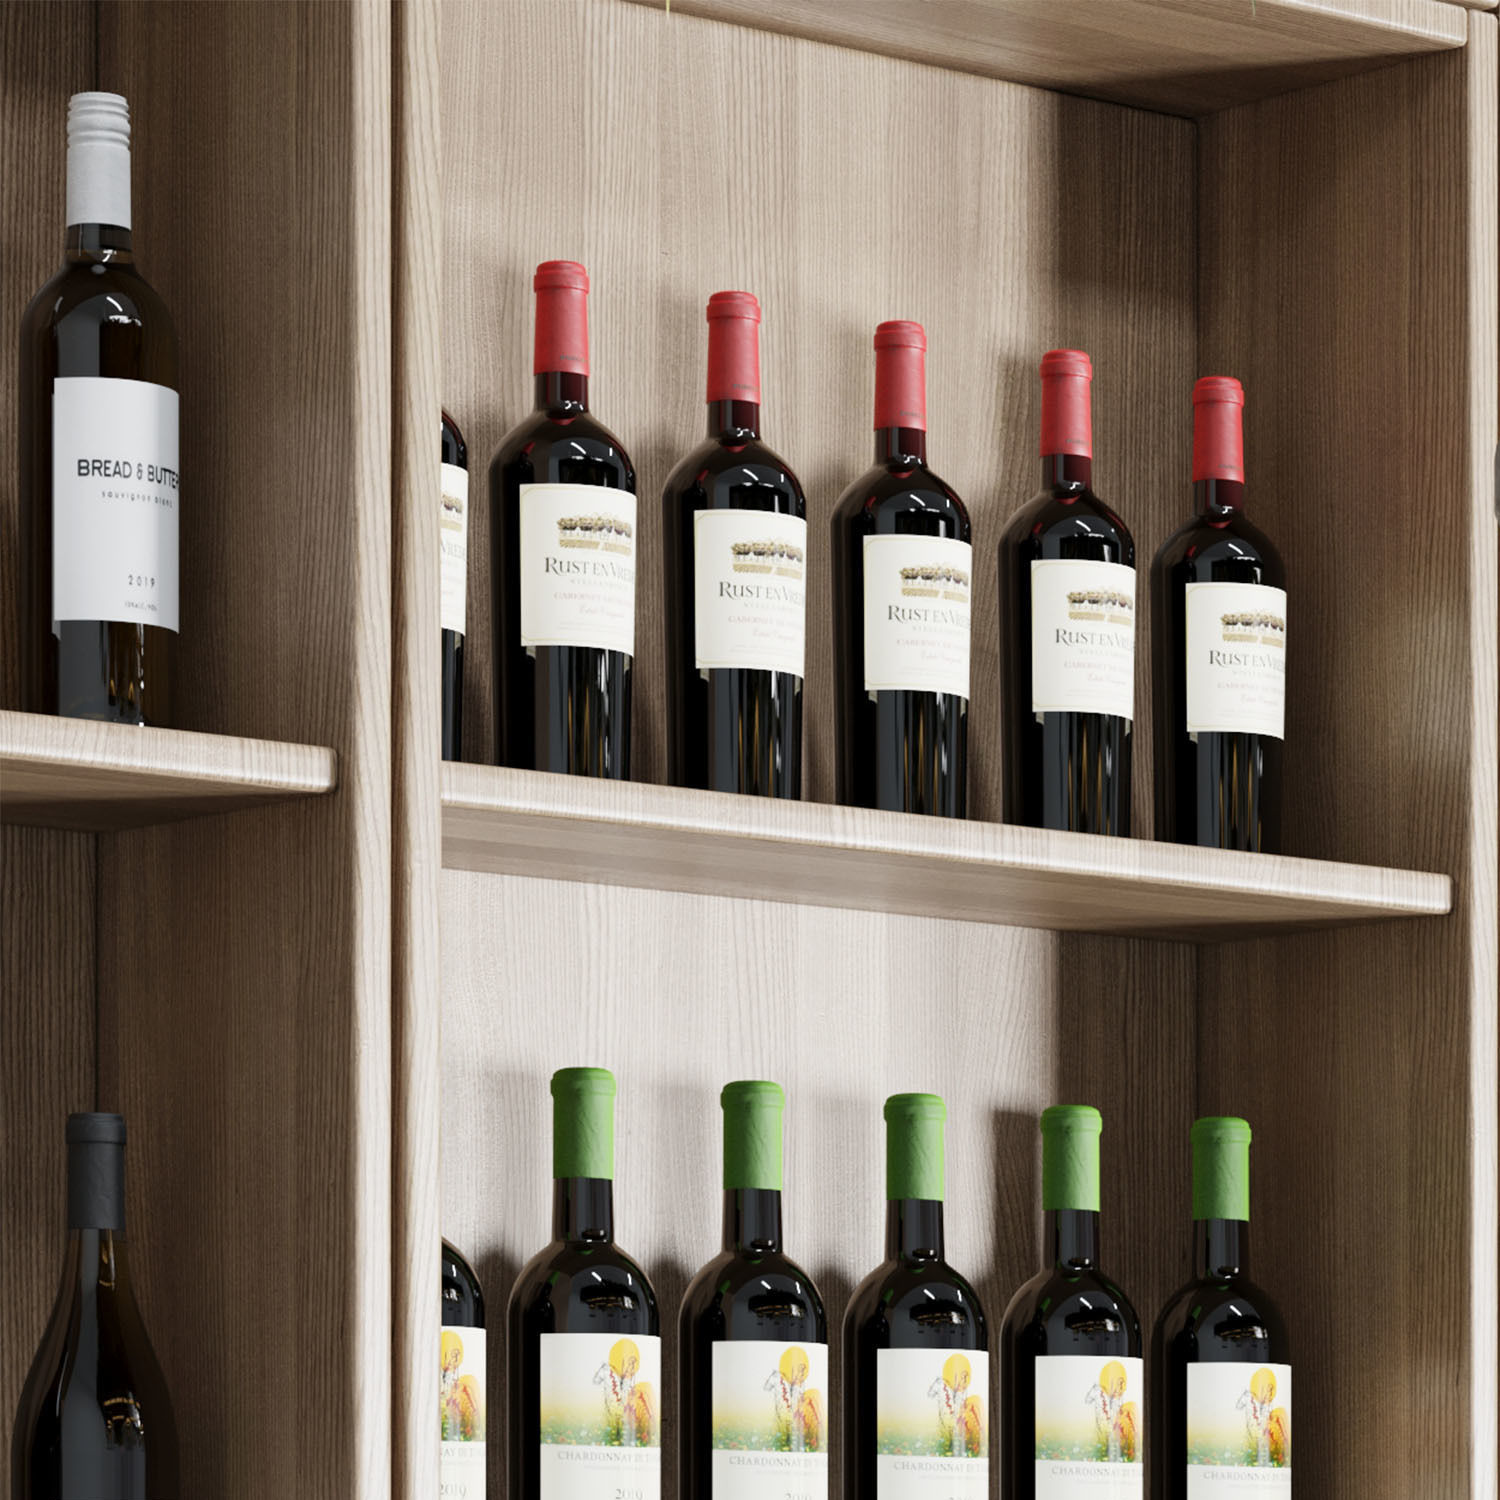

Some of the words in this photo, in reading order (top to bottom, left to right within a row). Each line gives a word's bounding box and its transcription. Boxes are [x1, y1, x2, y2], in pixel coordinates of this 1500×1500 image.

[77, 459, 132, 478] BREAD
[136, 462, 143, 480] &
[128, 574, 156, 588] 2019
